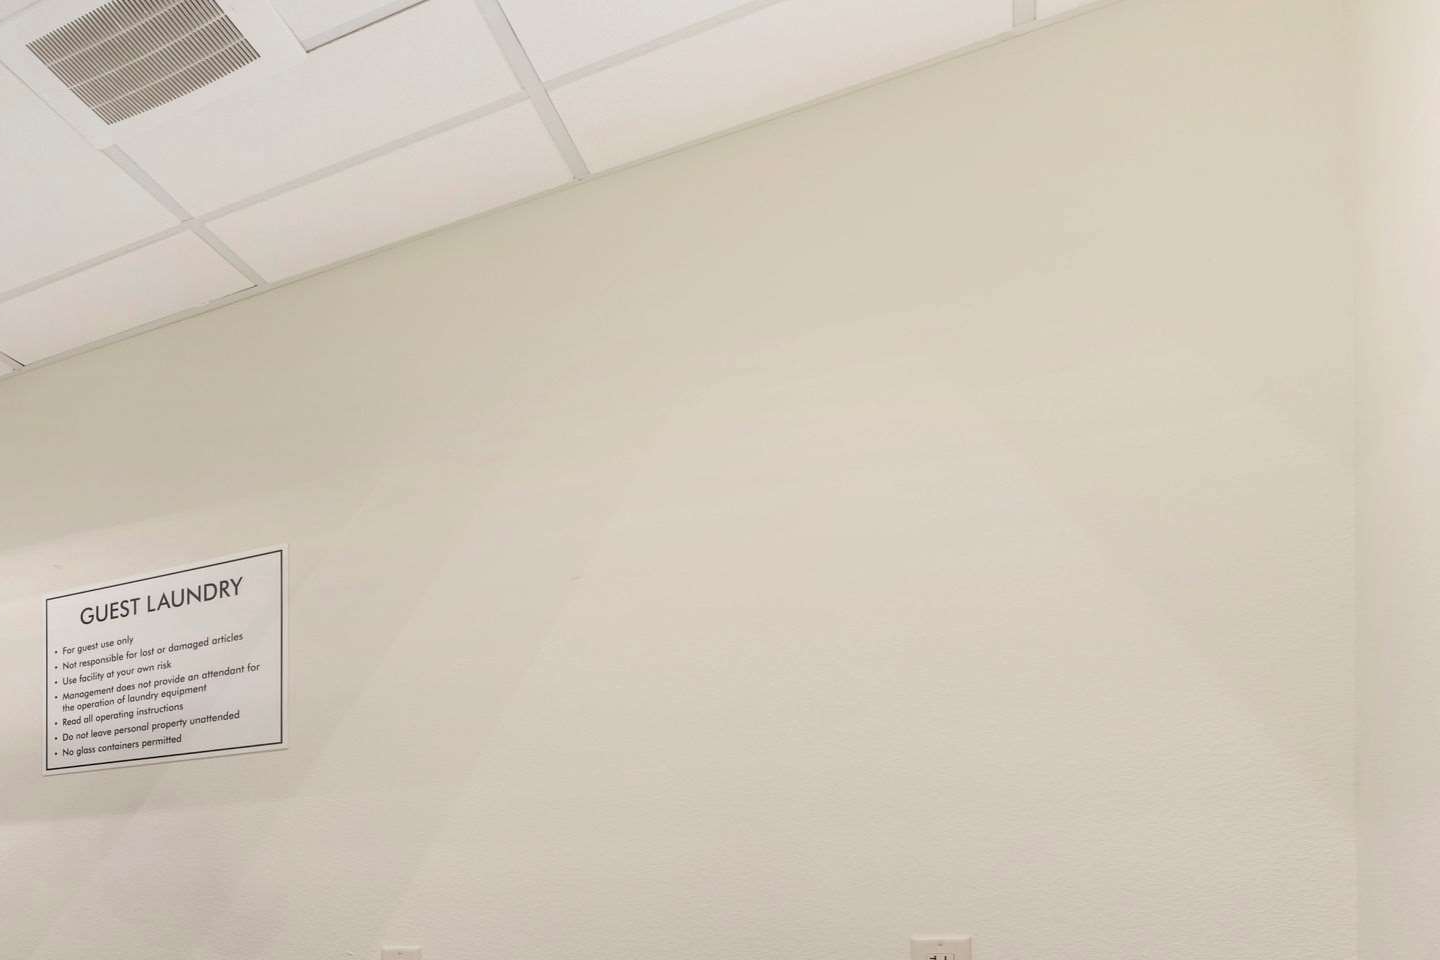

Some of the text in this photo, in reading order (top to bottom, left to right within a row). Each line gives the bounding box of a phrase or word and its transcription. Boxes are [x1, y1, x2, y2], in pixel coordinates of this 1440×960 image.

[80, 576, 243, 625] GUEST LAUNDRY
[63, 646, 75, 655] For
[77, 643, 98, 654] guest
[117, 635, 133, 645] only
[63, 662, 77, 670] Not
[79, 653, 123, 667] responsible
[126, 651, 138, 659] for
[140, 648, 154, 657] lost
[169, 637, 209, 652] damaged
[212, 632, 243, 645] articles
[63, 677, 77, 685] Use
[80, 672, 104, 682] facility
[117, 668, 134, 678] your
[137, 665, 154, 673] own
[157, 660, 172, 670] risk
[63, 686, 114, 700] Management
[117, 684, 135, 692] does
[154, 674, 185, 688] provide
[202, 665, 244, 679] attendant
[247, 663, 260, 672] for
[63, 684, 207, 712] the operation of laundry equipment
[63, 703, 184, 726] Read all operating instructions
[63, 733, 73, 741] Do
[91, 729, 111, 738] leave
[114, 722, 149, 735] personal
[152, 719, 187, 732] property
[190, 710, 240, 725] unattended
[63, 734, 181, 756] No glass containers permitted
